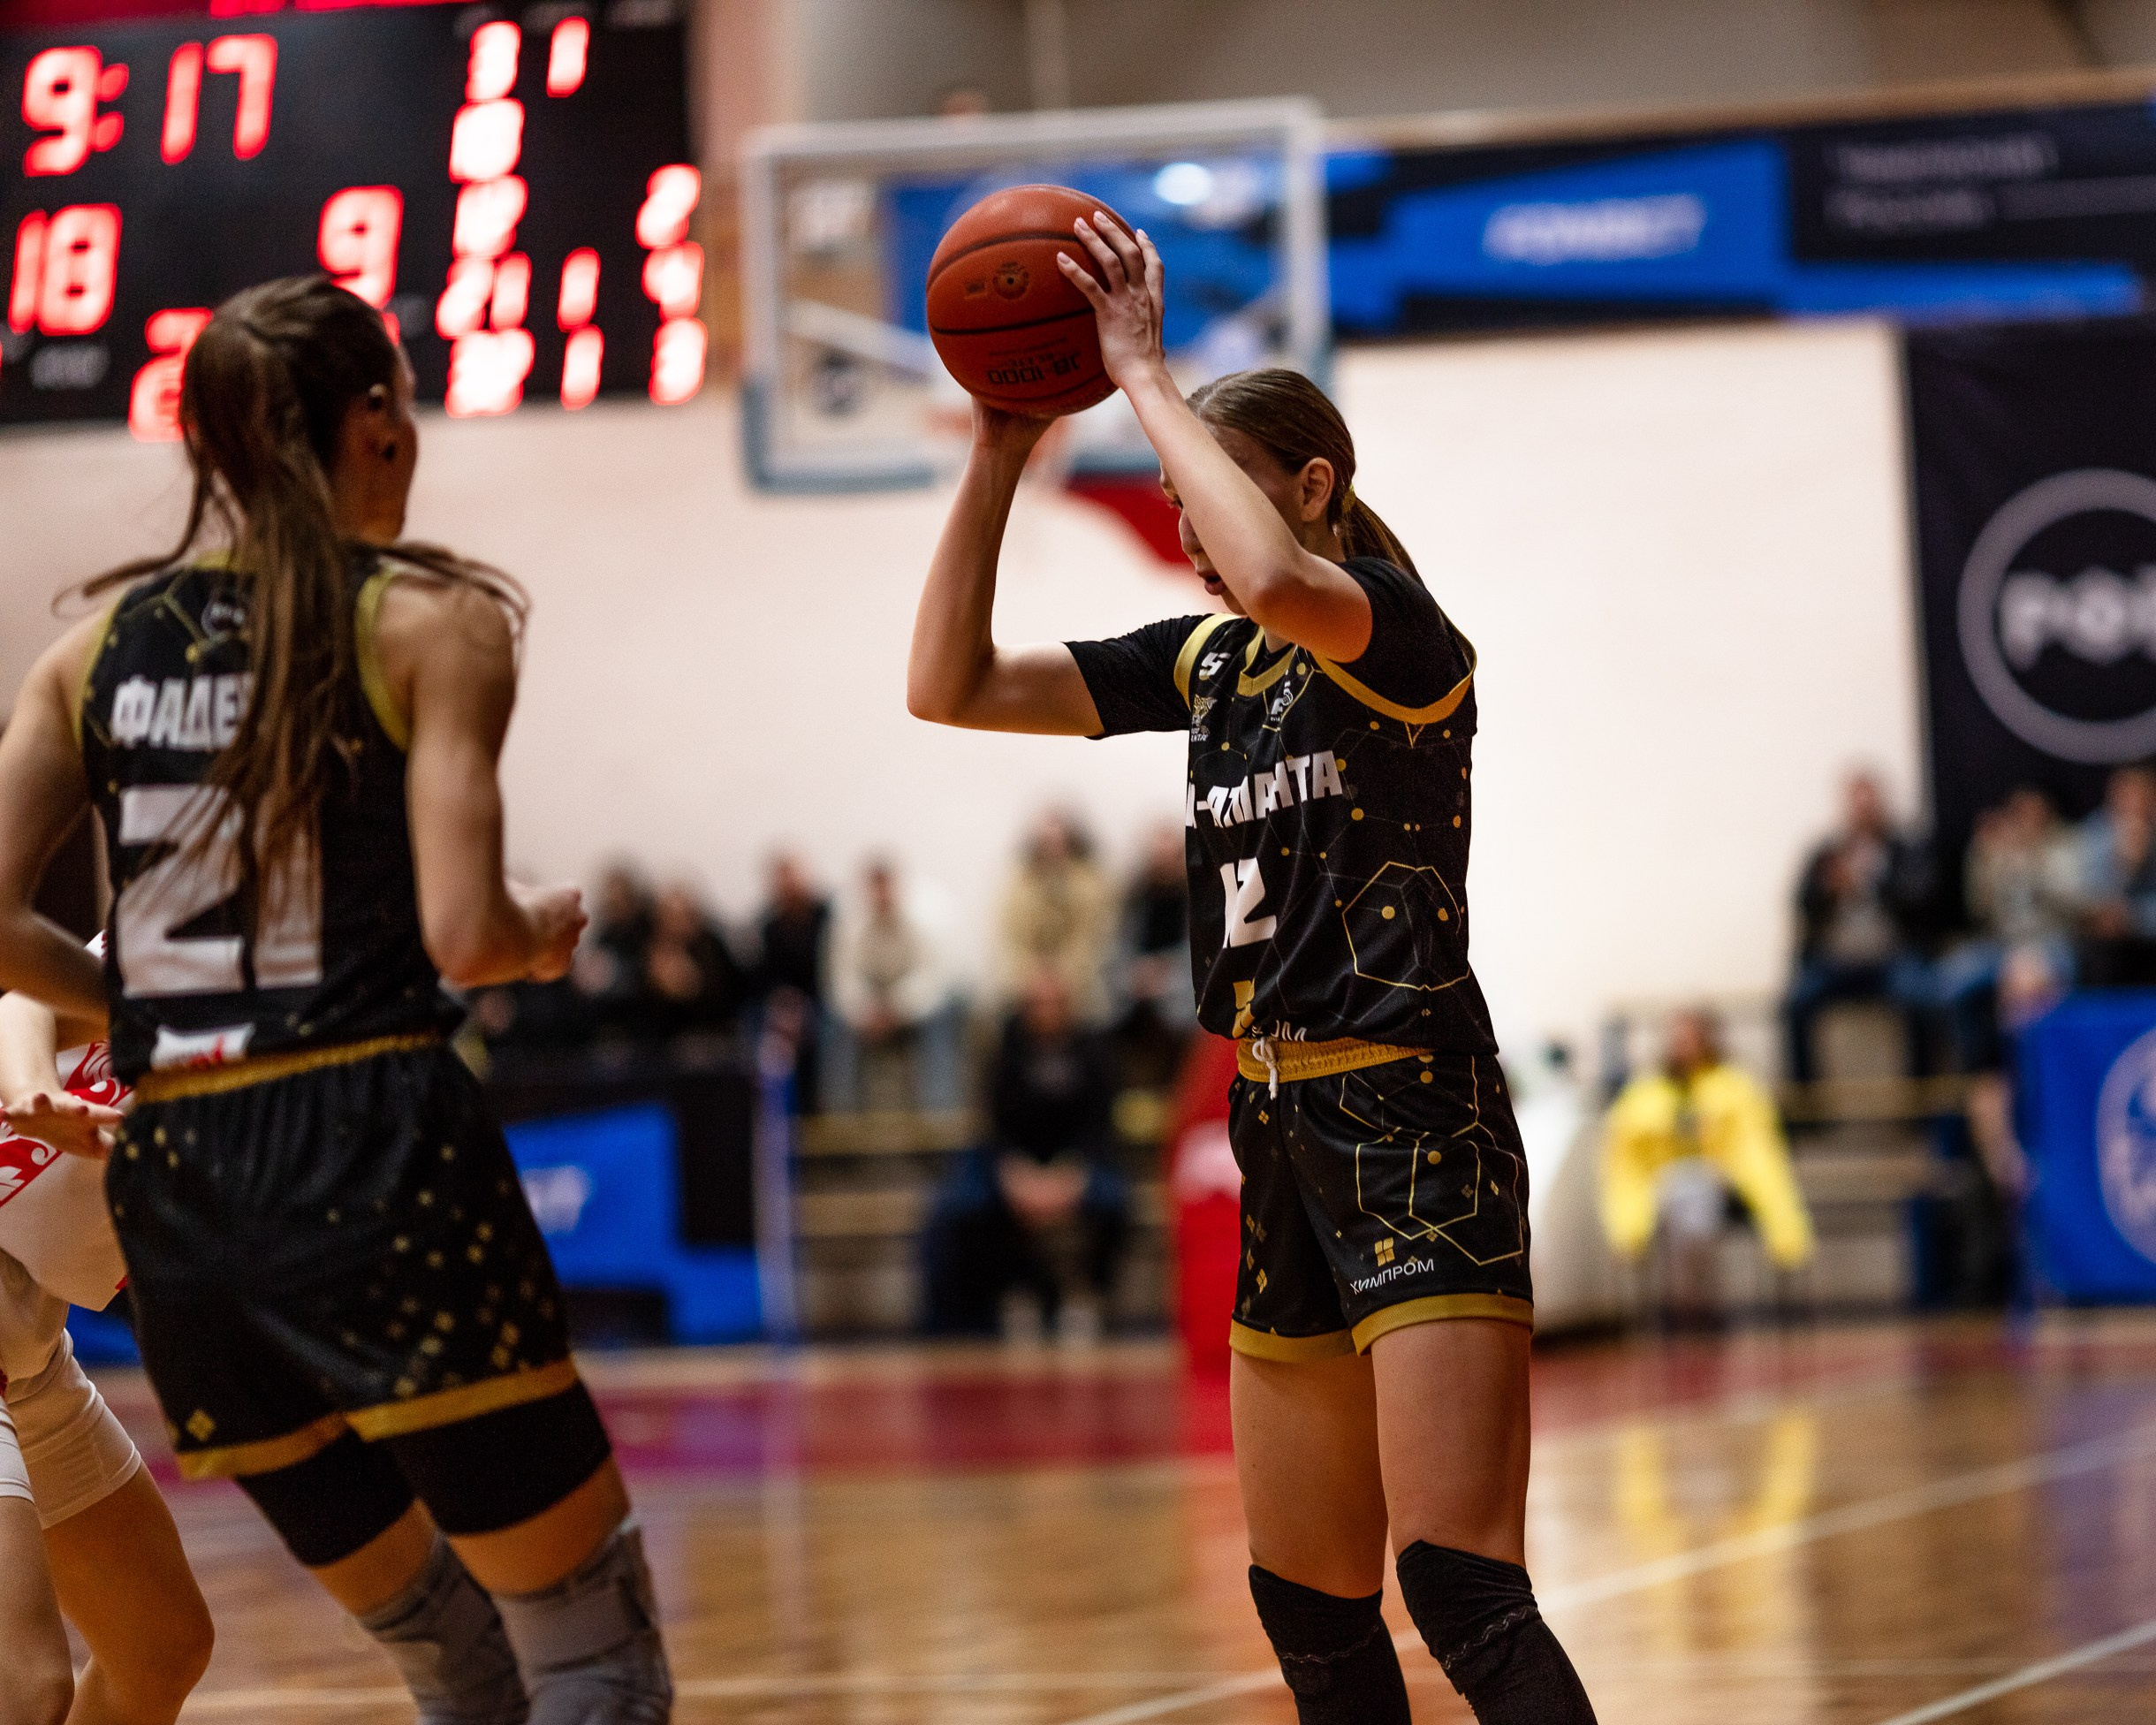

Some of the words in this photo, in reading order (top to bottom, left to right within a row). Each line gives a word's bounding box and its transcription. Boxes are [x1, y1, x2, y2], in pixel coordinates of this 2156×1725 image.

[22, 34, 277, 176] 9:17
[7, 202, 122, 335] 18
[317, 185, 403, 308] 9
[110, 672, 255, 751] ФАДЕ
[118, 783, 324, 999] 21
[1219, 856, 1278, 950] 12
[1349, 1258, 1435, 1296] ХИМПРОМ
